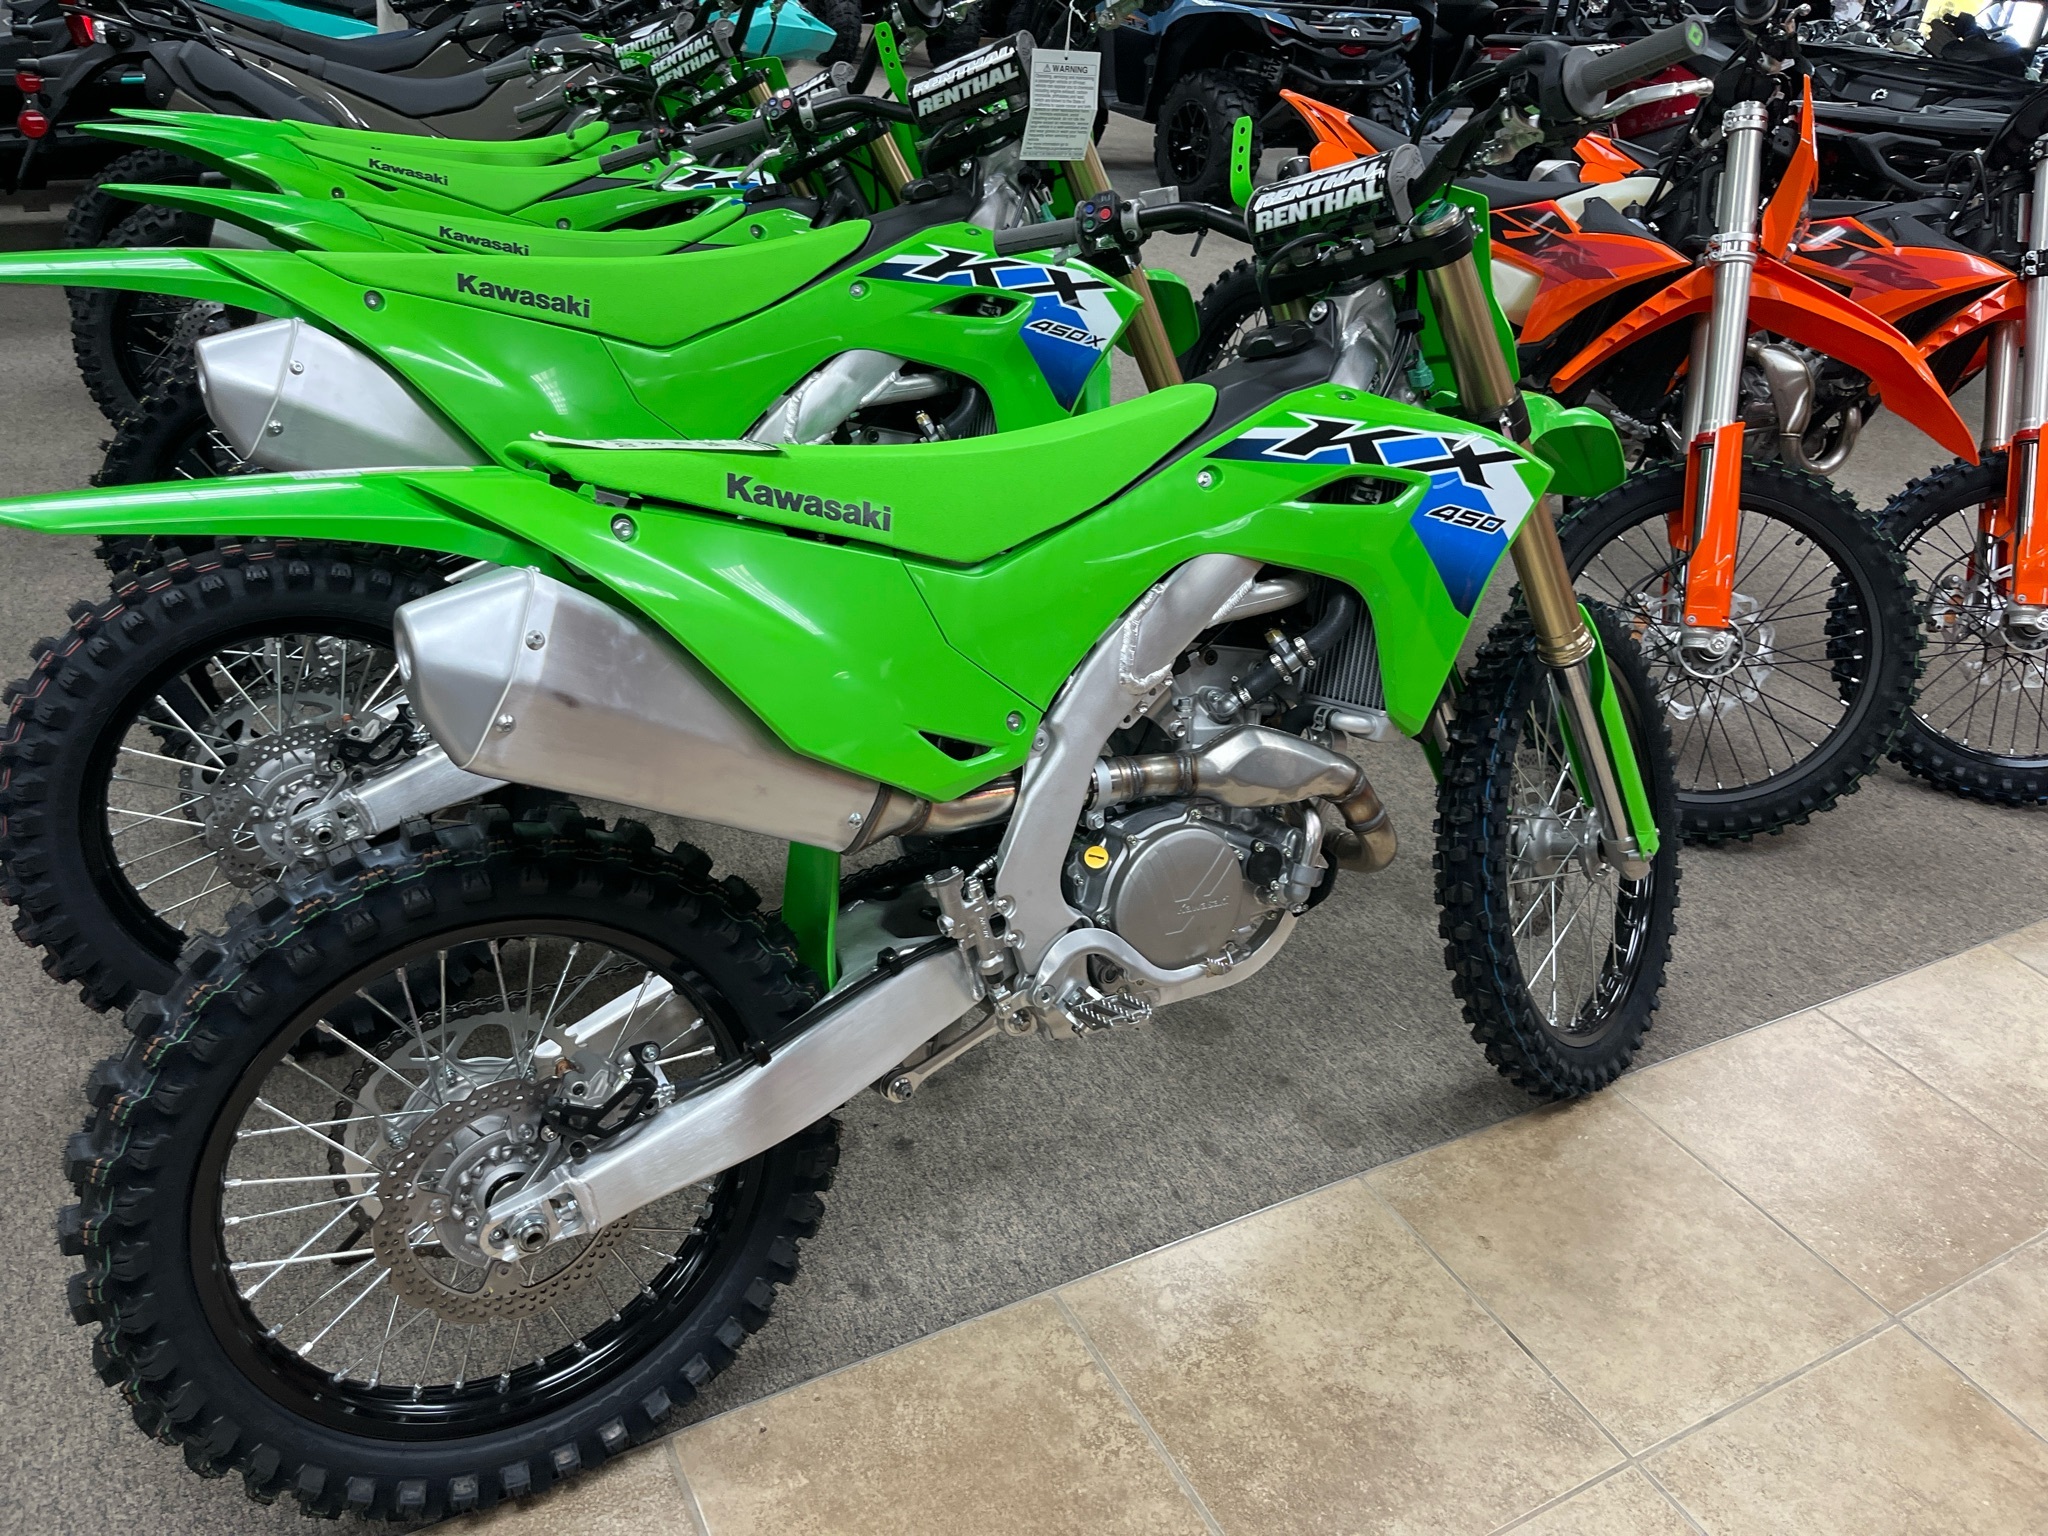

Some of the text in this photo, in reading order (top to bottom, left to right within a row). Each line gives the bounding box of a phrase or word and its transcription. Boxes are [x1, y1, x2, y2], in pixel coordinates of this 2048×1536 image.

[614, 26, 674, 58] RENTHAL
[650, 34, 714, 77] RENTHAL
[656, 48, 720, 87] RENTHAL
[917, 62, 1019, 117] RENTHAL
[1052, 65, 1088, 73] WARNING
[368, 158, 449, 186] Kawasaki
[1253, 161, 1384, 212] RENTHAL
[1255, 179, 1384, 234] RENTHAL
[439, 225, 530, 257] Kawasaki
[456, 272, 591, 319] Kawasaki
[908, 247, 1114, 312] KX
[1270, 414, 1525, 491] KX
[726, 472, 892, 532] Kawasaki
[1429, 505, 1507, 534] 450
